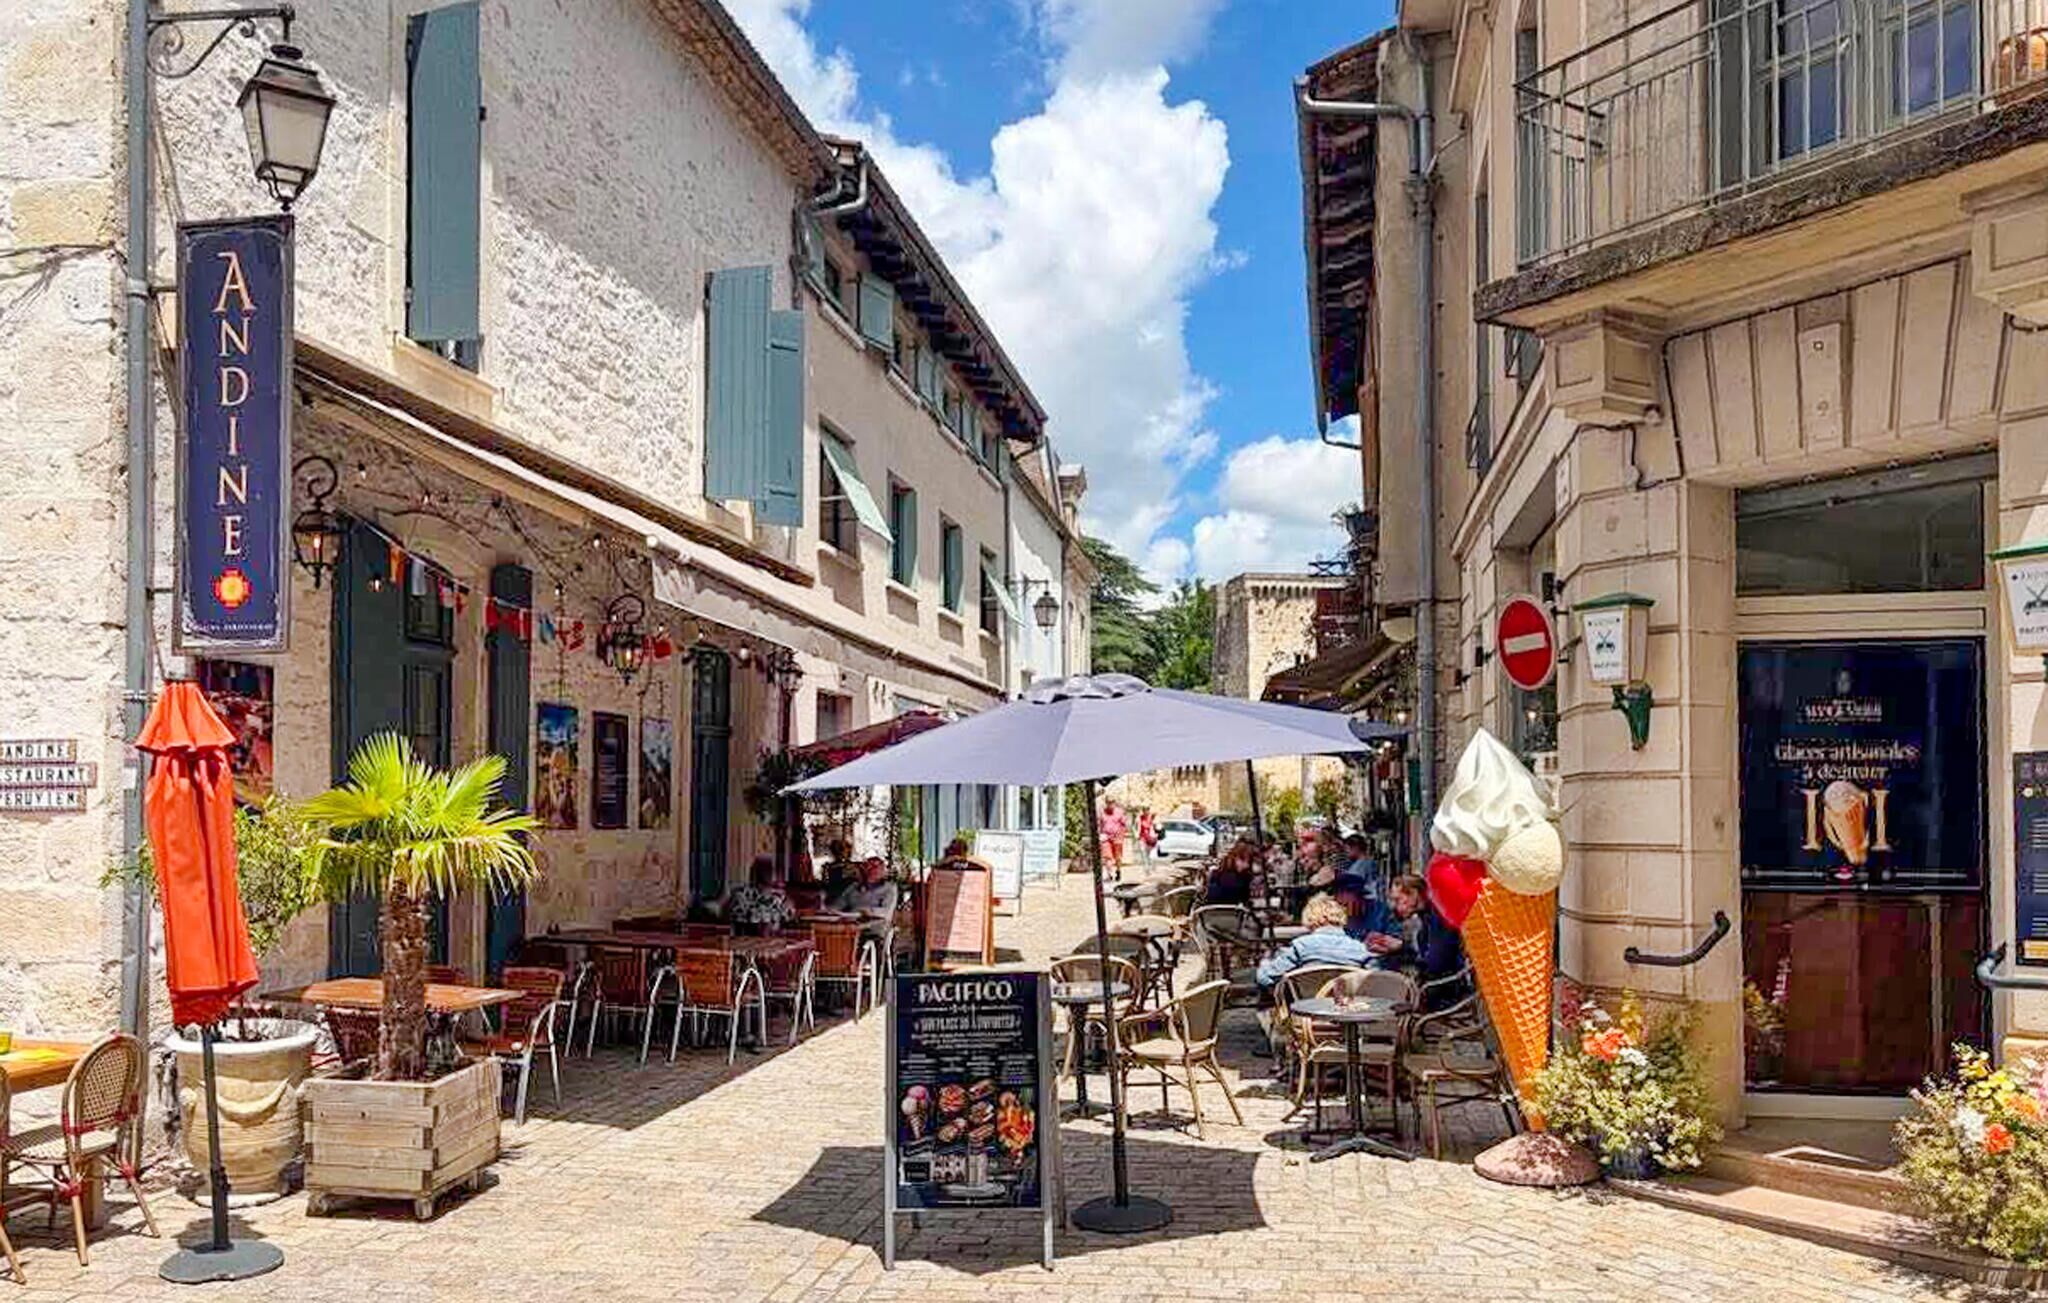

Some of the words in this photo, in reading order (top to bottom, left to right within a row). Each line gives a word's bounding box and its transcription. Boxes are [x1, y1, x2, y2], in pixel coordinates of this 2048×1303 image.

[212, 251, 257, 557] ANDINE
[4, 744, 64, 759] ANDINE
[0, 768, 85, 782] STAURANT
[918, 981, 1013, 1003] PACIFICO
